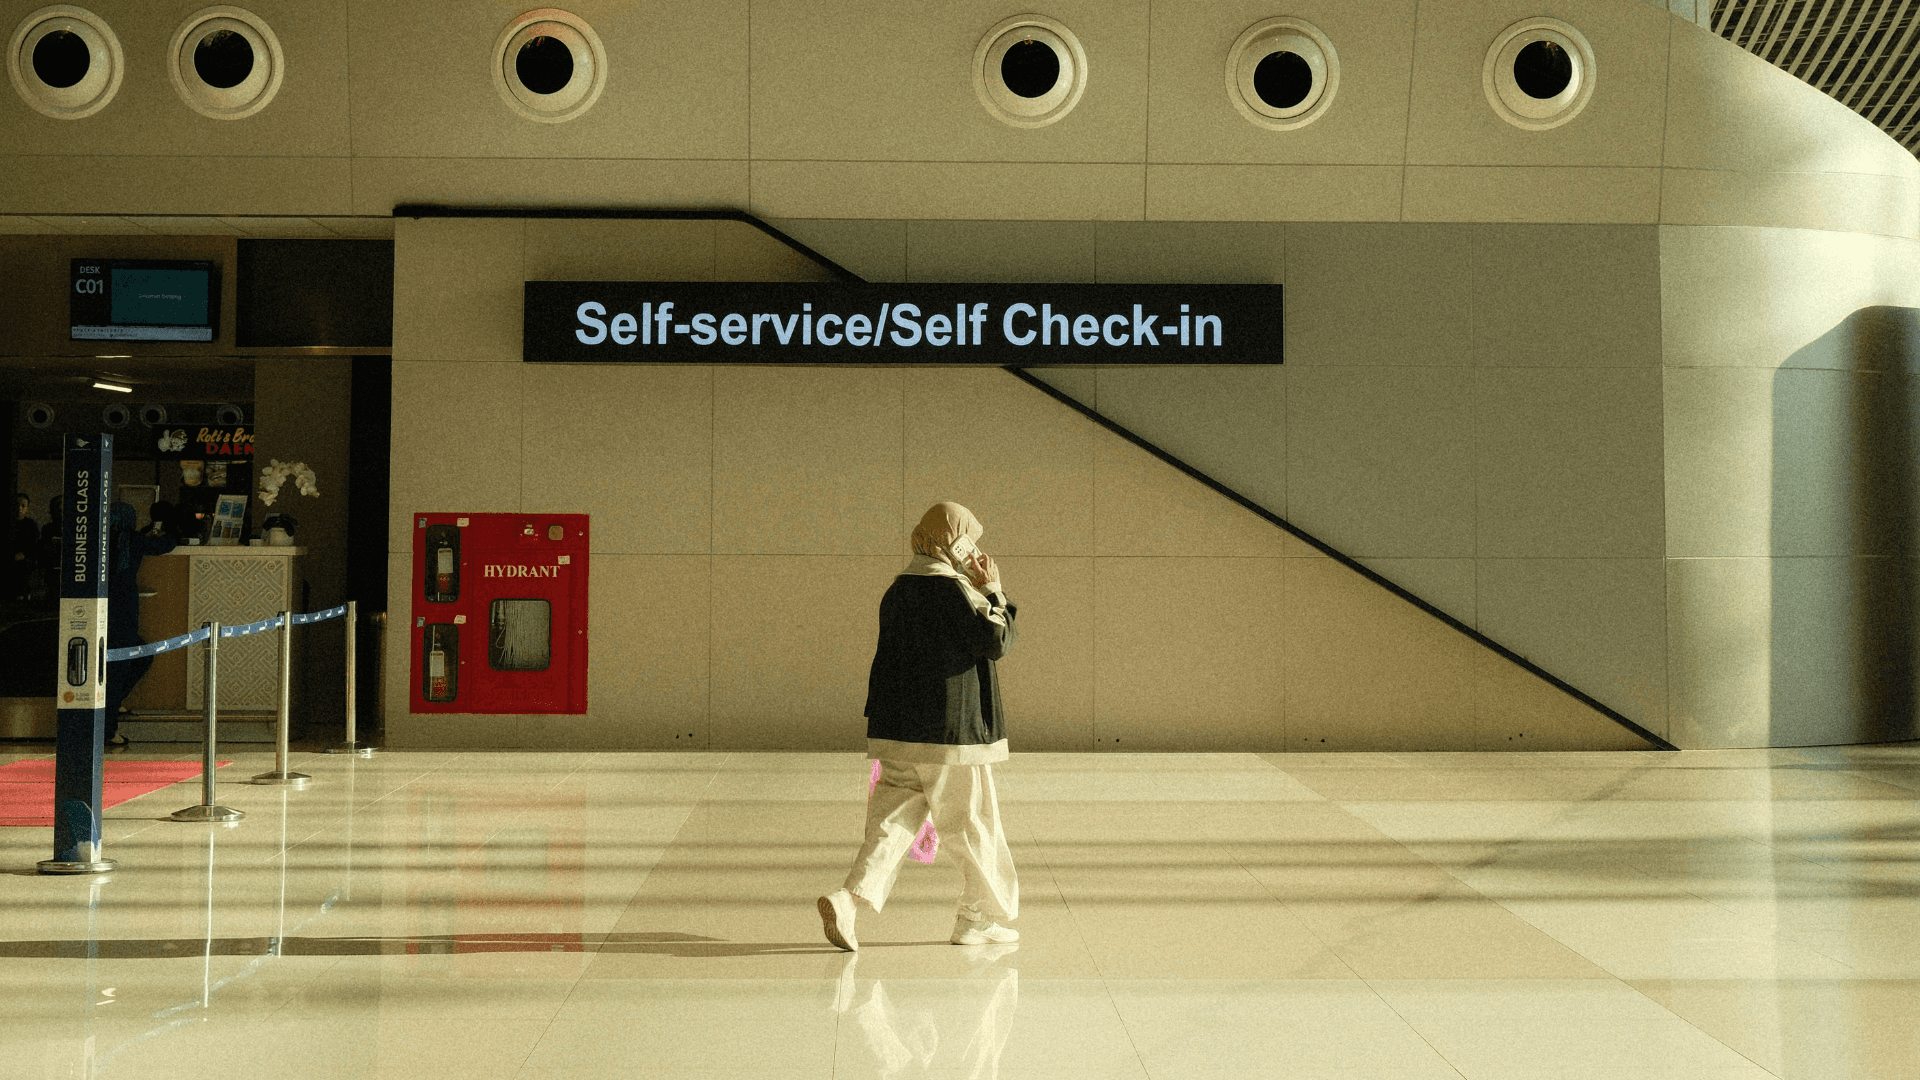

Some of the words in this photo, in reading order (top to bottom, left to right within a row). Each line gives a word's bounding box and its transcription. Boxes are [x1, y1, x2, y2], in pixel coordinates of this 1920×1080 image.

[80, 266, 101, 274] DESK
[75, 279, 105, 294] C01
[575, 301, 988, 348] Self-service/Self
[1003, 302, 1223, 347] Check-in
[196, 427, 224, 442] Roti
[76, 470, 90, 513] CLASS
[75, 516, 88, 583] BUSINESS
[484, 565, 560, 578] HYDRANT
